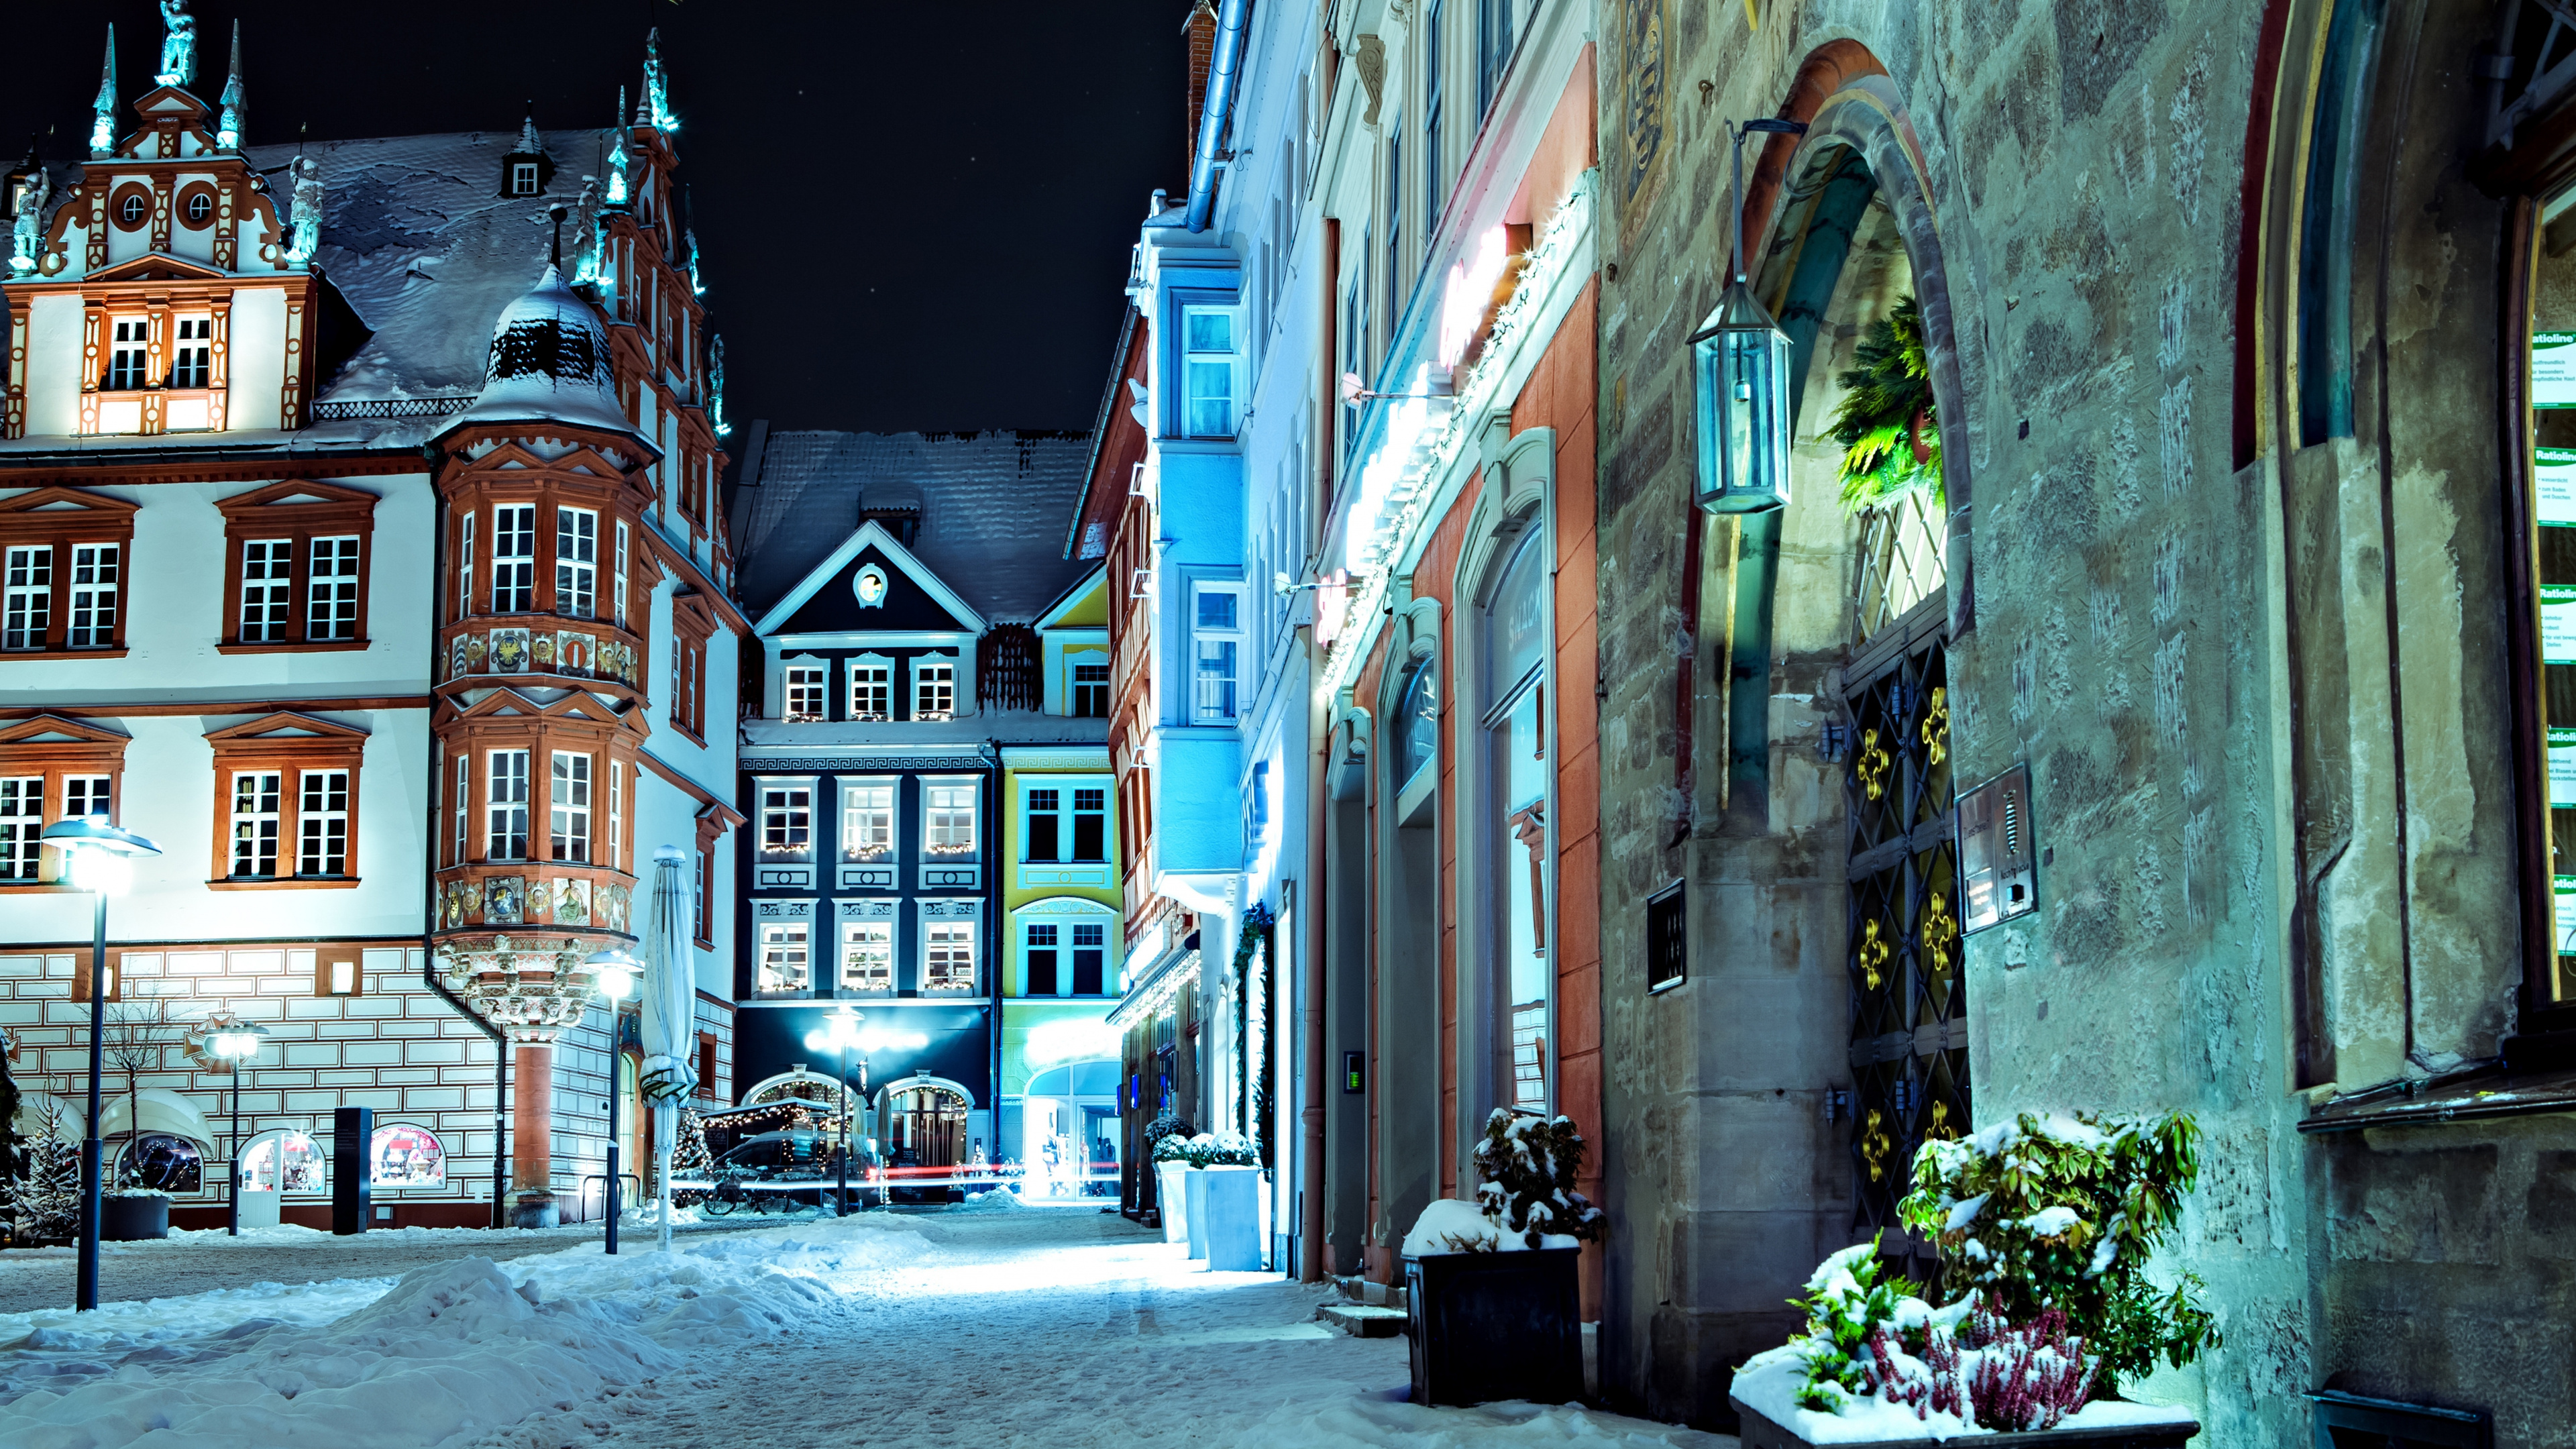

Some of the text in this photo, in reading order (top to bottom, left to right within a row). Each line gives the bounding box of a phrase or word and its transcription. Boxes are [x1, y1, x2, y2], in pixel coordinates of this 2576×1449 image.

[2532, 333, 2573, 343] atioline
[2536, 450, 2576, 461] Ratiolin
[2554, 879, 2576, 889] atiol
